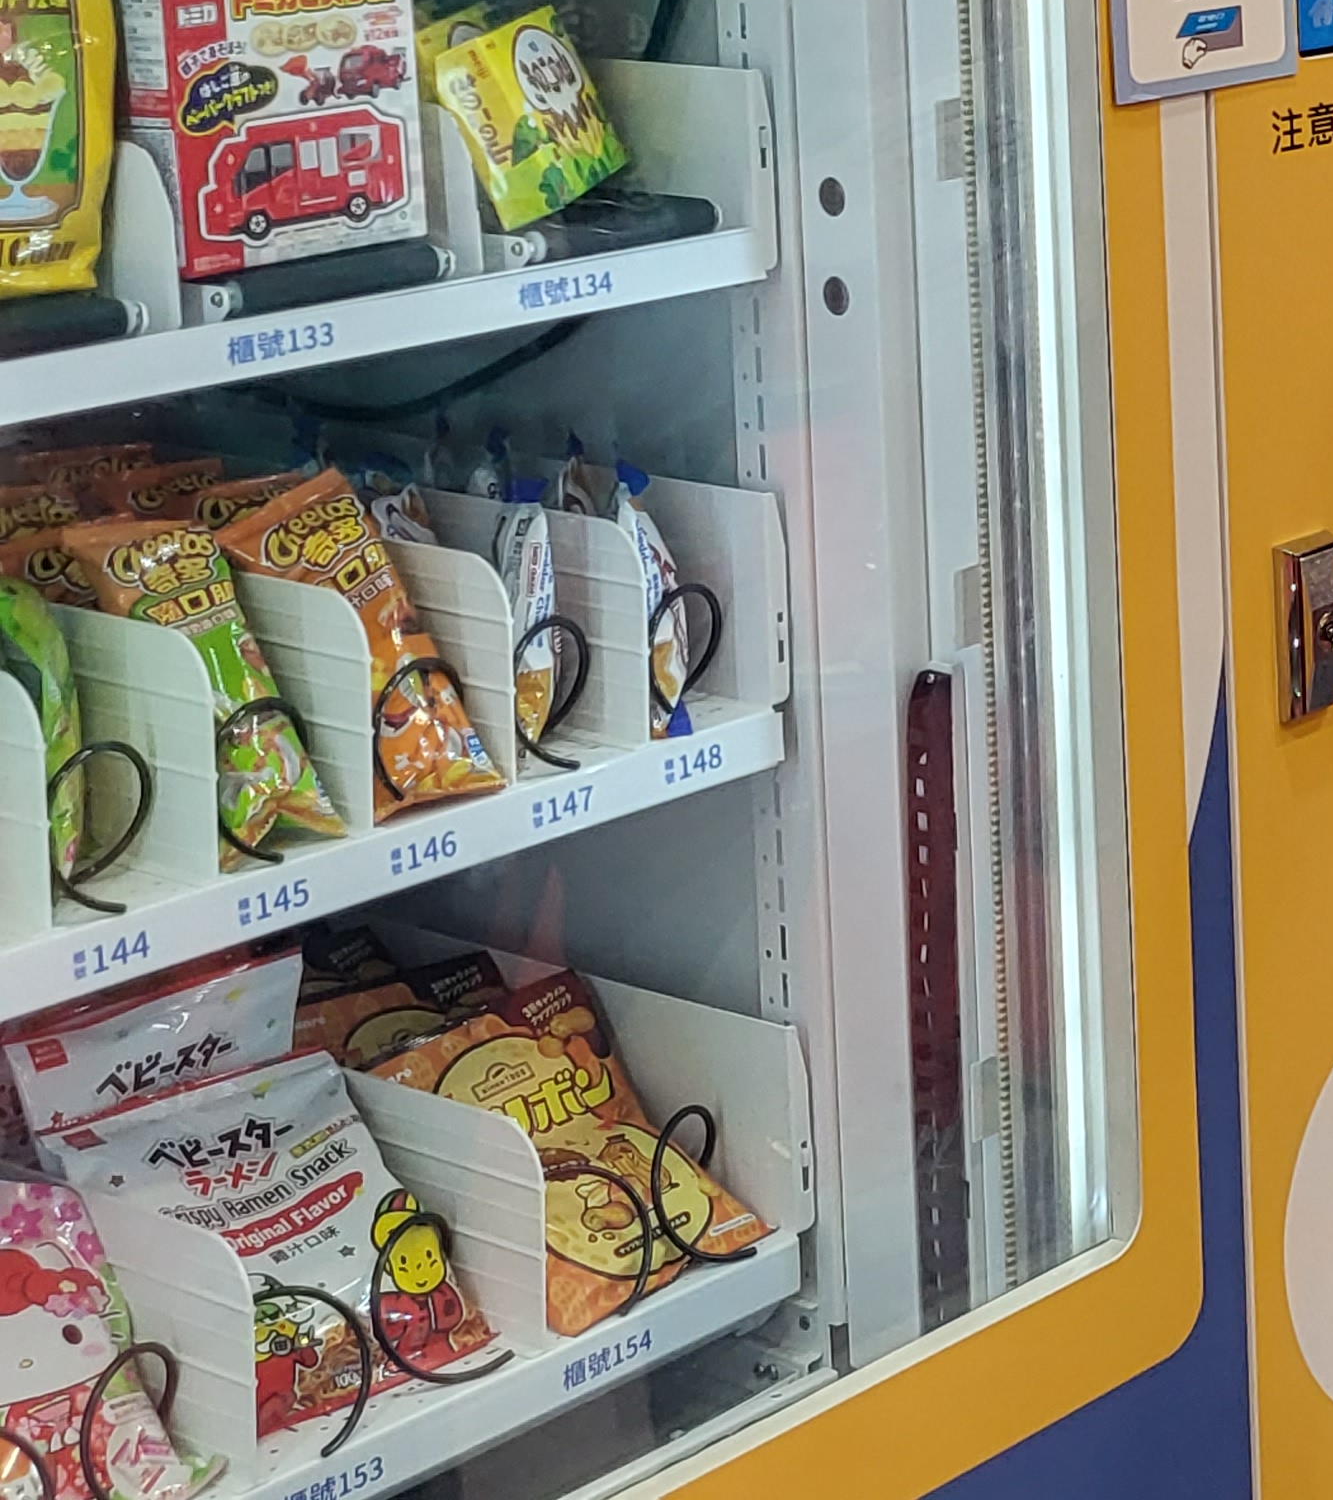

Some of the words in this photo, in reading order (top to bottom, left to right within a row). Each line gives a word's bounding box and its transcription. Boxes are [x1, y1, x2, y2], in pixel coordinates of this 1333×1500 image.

[518, 271, 613, 311] 櫃號134
[227, 322, 335, 367] 櫃號133
[679, 744, 722, 781] 148
[548, 785, 594, 824] 147
[407, 831, 457, 871] 146
[255, 880, 310, 920] 145
[92, 932, 150, 975] 144
[96, 1033, 233, 1096] ベビースター
[149, 1118, 294, 1169] ベビースター
[185, 1152, 278, 1197] ラーメン
[222, 1182, 292, 1220] Ramen
[291, 1140, 356, 1189] Snack
[226, 1217, 292, 1252] Original
[296, 1184, 349, 1228] Flavor
[564, 1329, 652, 1391] 櫃號154
